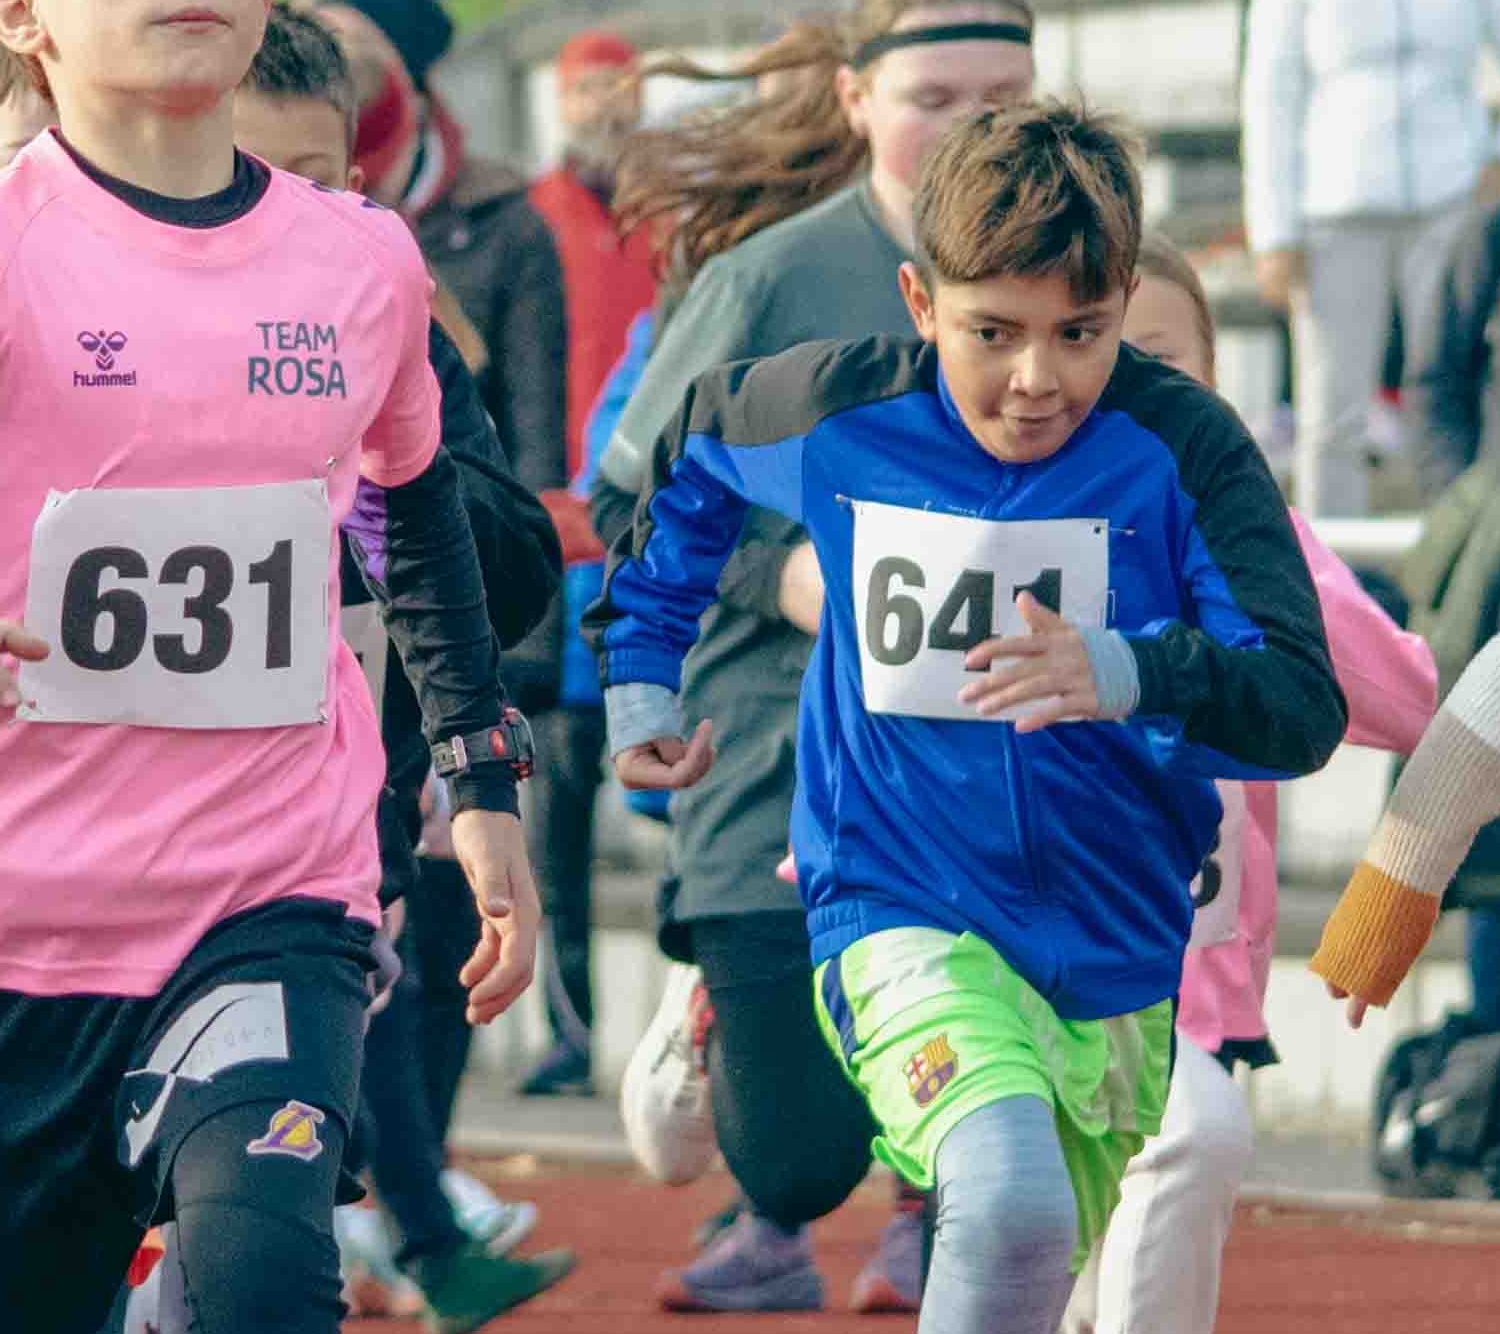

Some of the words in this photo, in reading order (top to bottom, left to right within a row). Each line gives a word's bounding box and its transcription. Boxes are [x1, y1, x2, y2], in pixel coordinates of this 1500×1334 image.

[256, 321, 338, 353] TEAM
[73, 370, 138, 388] hummel
[247, 356, 347, 399] ROSA
[60, 539, 292, 673] 631
